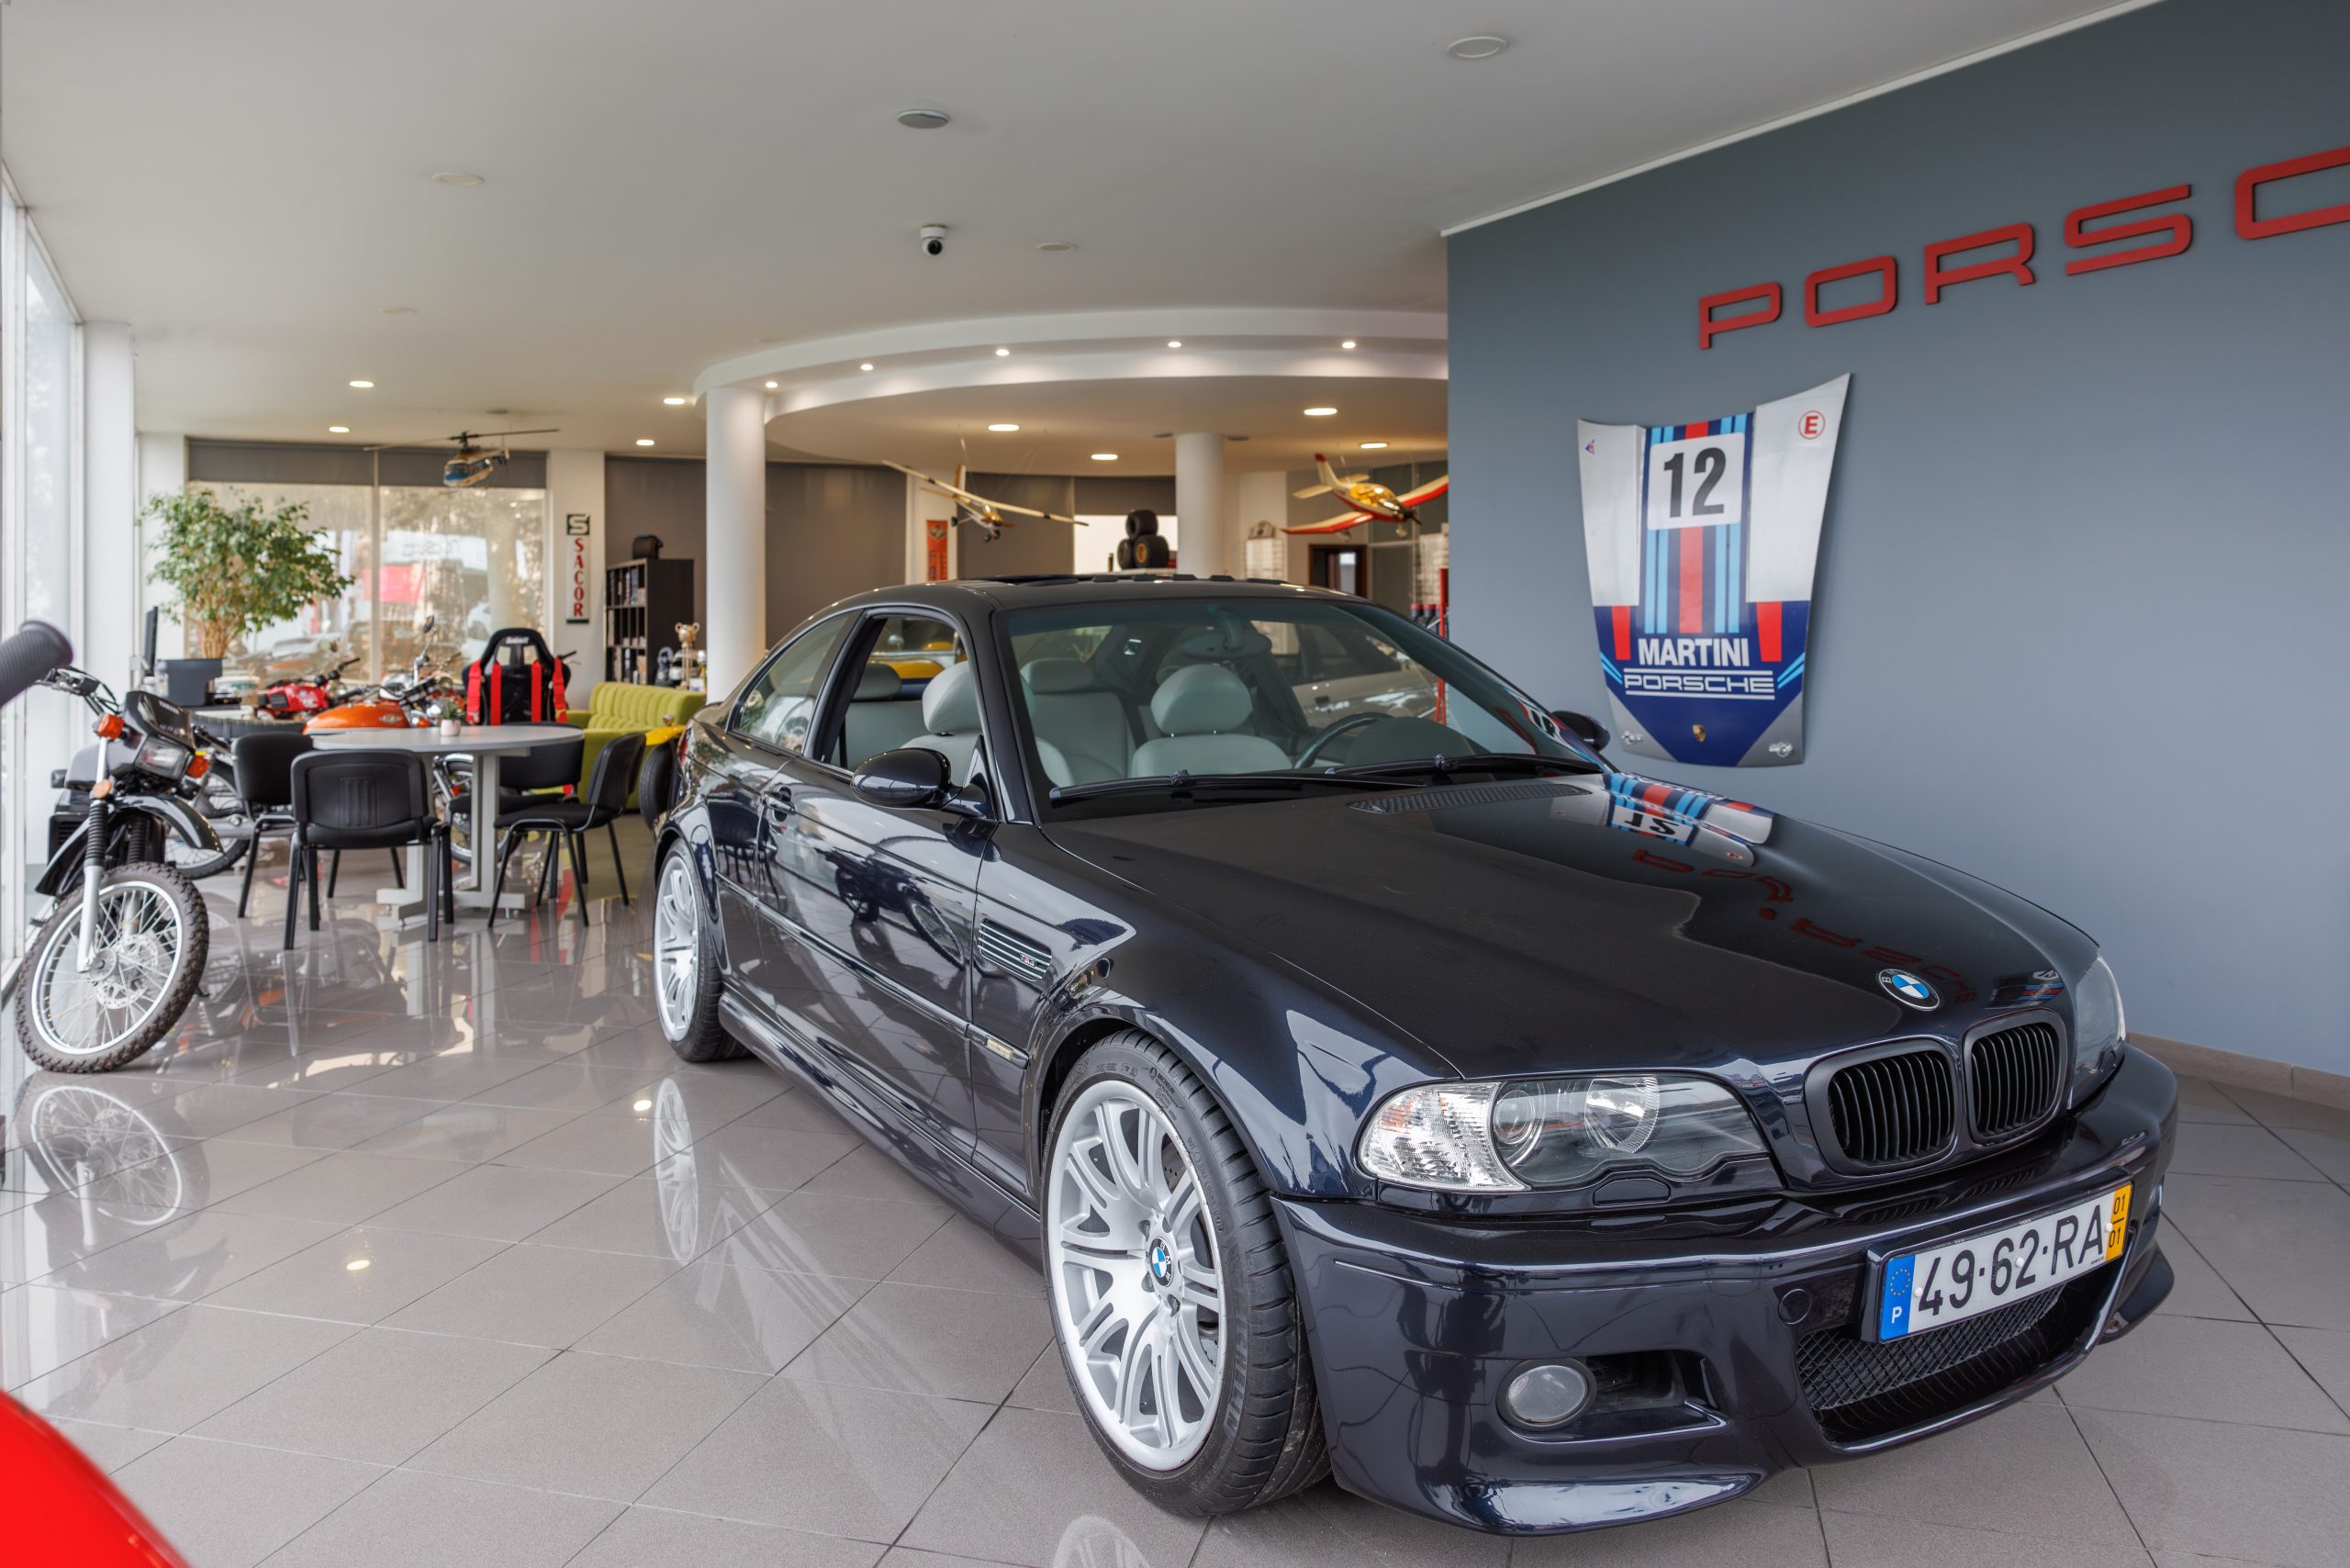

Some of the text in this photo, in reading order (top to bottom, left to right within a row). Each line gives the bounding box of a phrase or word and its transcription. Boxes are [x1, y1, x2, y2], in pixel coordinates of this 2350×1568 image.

[1804, 415, 1819, 435] E
[1663, 447, 1726, 518] 12
[573, 537, 585, 617] SACOR
[1638, 637, 1750, 666] MARTINI
[1623, 674, 1775, 693] PORSCHE
[2113, 1197, 2126, 1215] 01
[2109, 1229, 2122, 1249] 01
[1891, 1306, 1903, 1324] P
